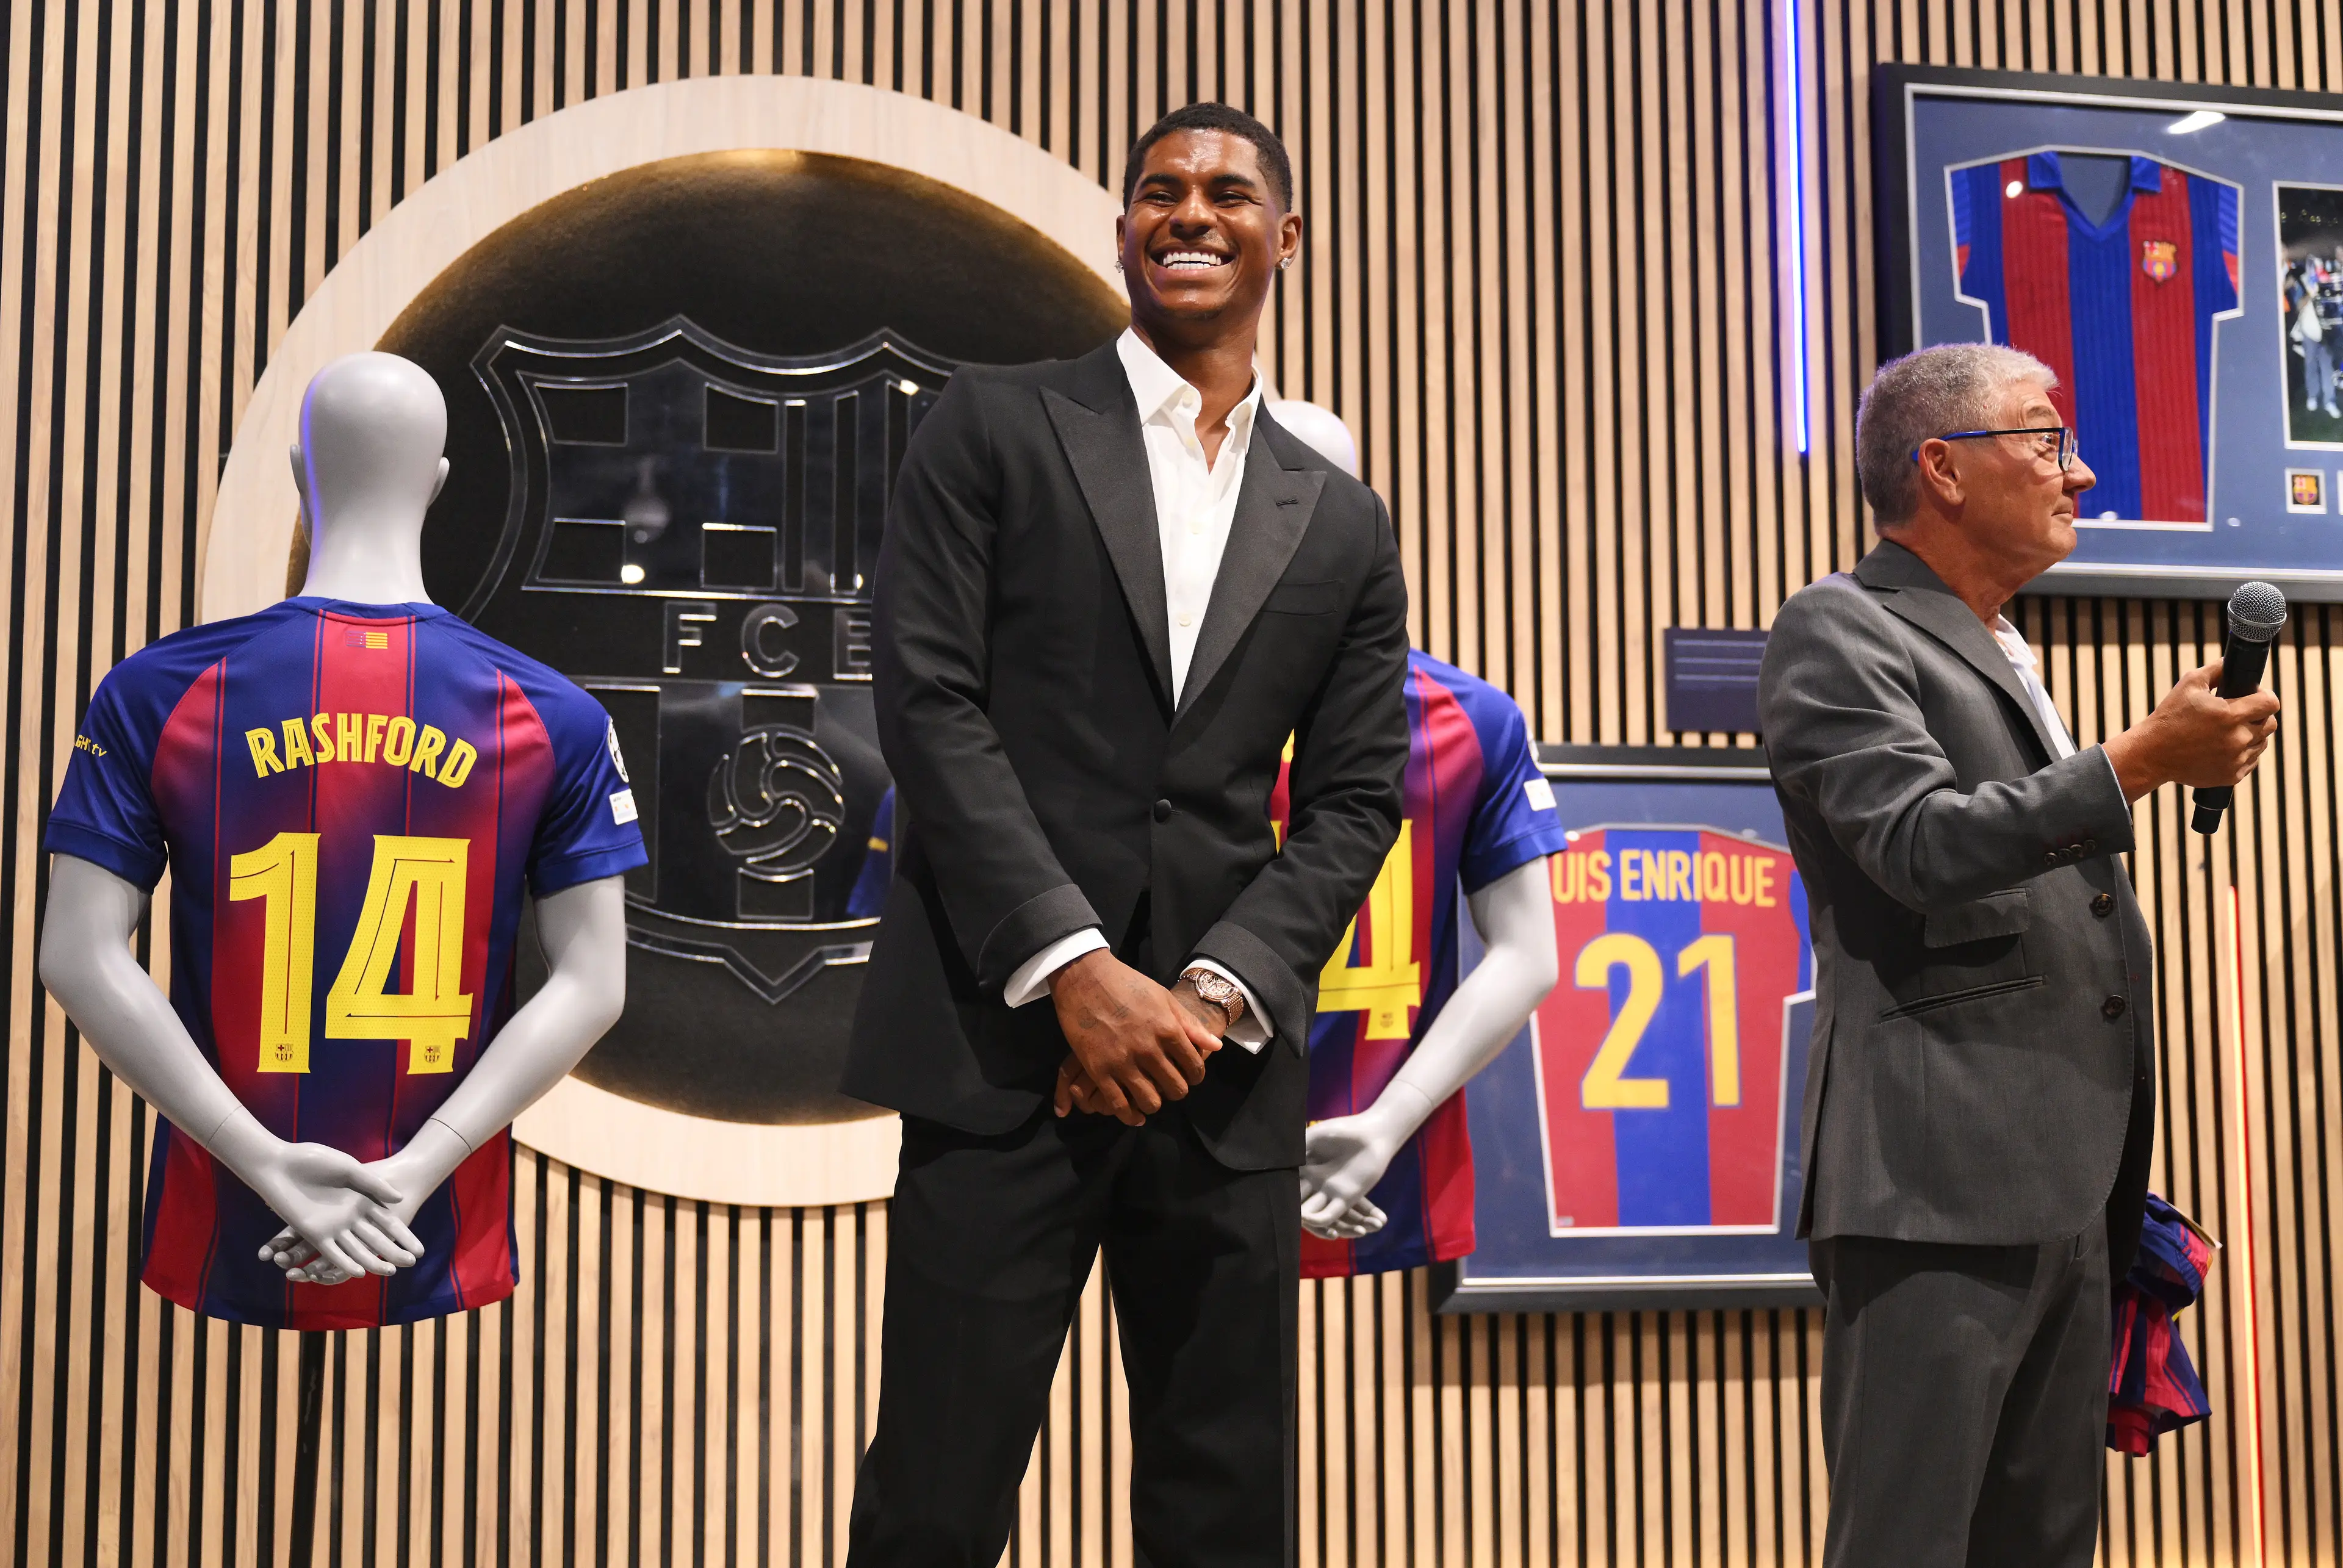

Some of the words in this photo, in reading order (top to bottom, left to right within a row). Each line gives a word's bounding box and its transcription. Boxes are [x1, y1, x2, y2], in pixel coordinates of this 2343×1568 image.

[245, 713, 478, 788] RASHFORD
[1552, 851, 1612, 904] UIS
[1619, 849, 1777, 907] ENRIQUE
[229, 832, 472, 1074] 14
[1575, 932, 1741, 1109] 21
